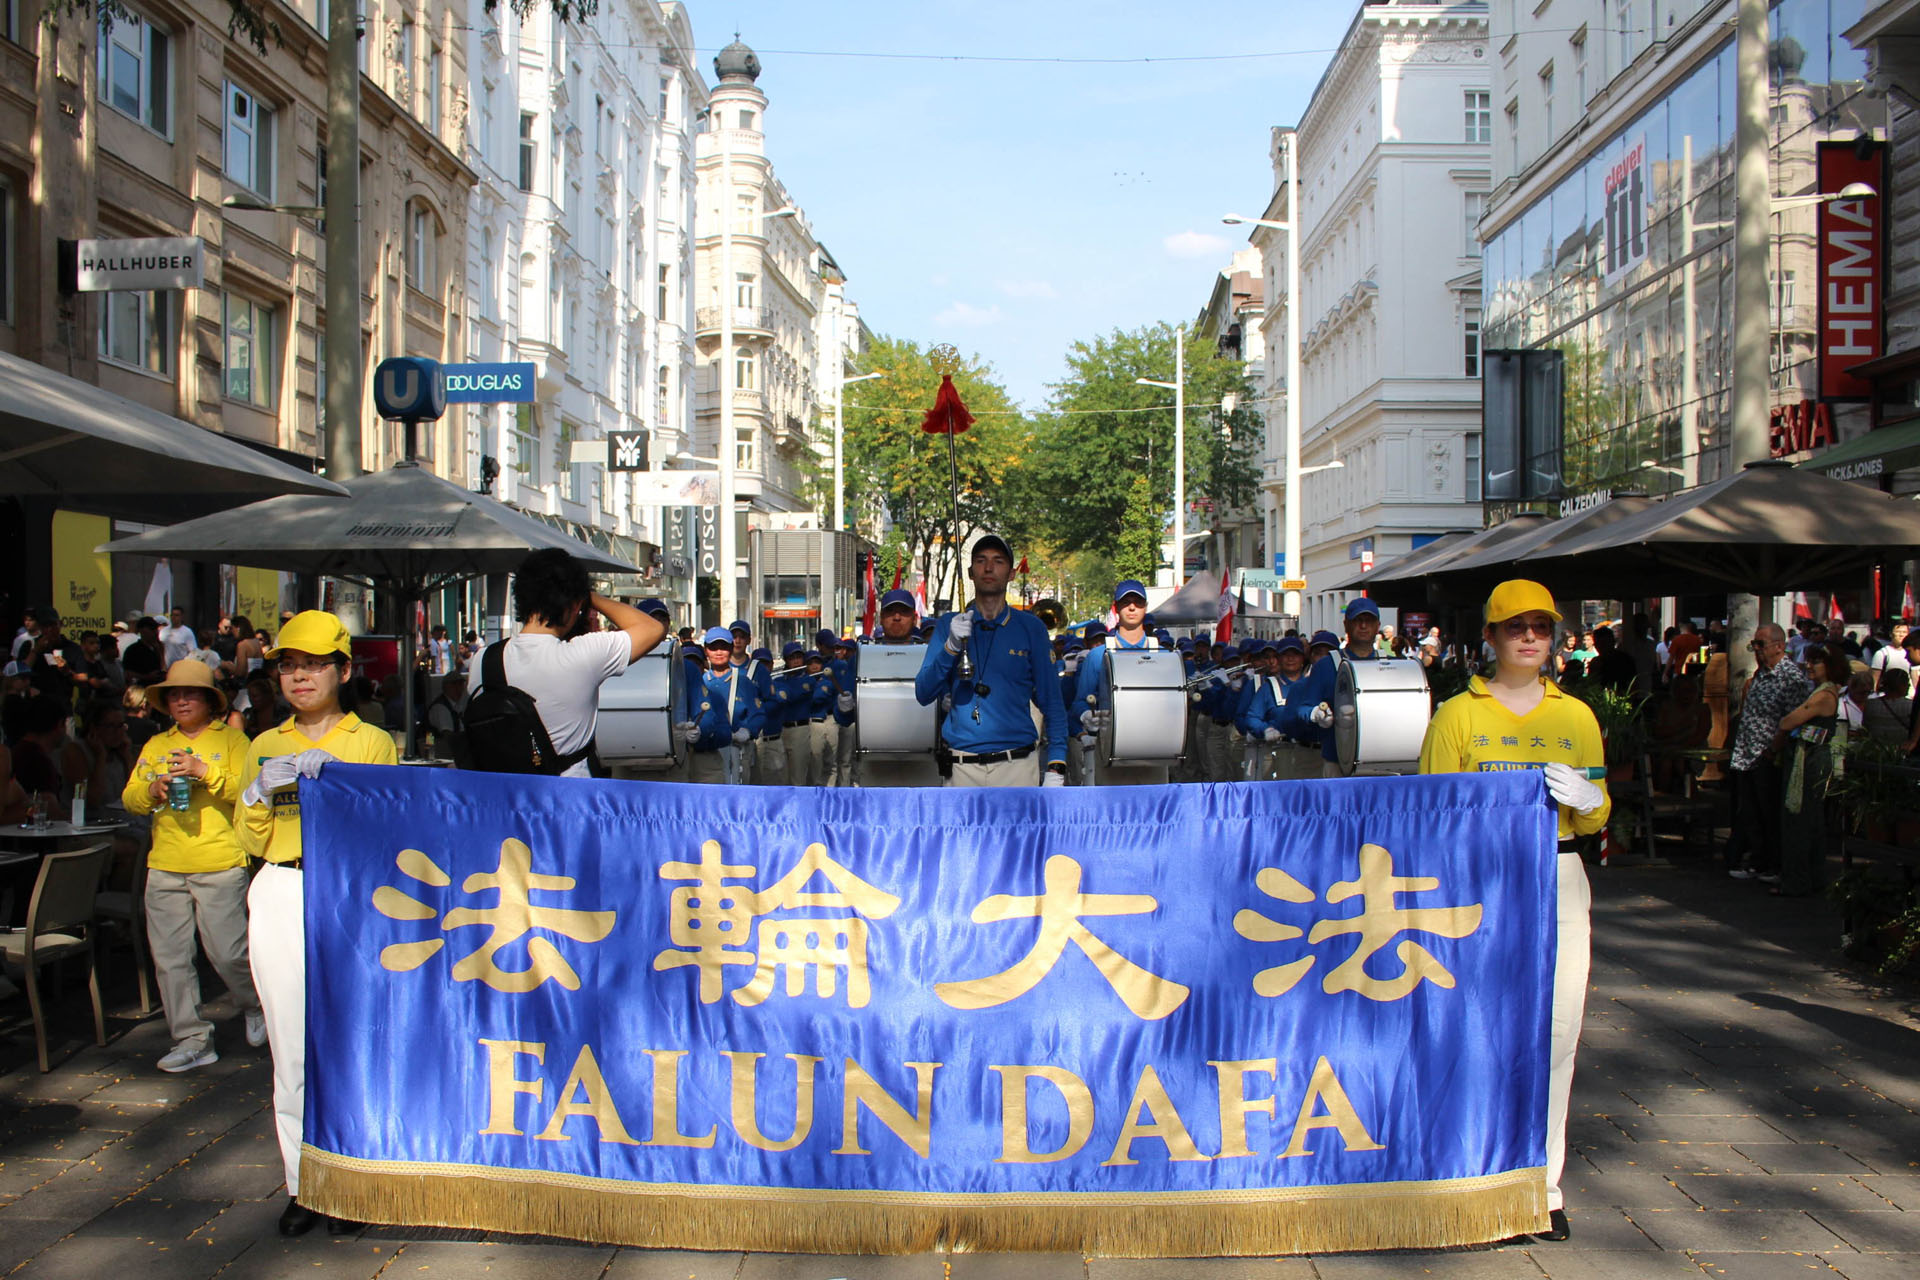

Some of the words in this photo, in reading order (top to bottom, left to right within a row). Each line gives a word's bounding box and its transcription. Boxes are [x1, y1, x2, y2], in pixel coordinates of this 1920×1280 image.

[1604, 143, 1644, 194] clever
[1605, 165, 1644, 276] fit
[82, 254, 194, 273] HALLHUBER
[1828, 200, 1873, 355] HEMA
[383, 369, 419, 409] U
[446, 374, 522, 391] DOUGLAS
[61, 616, 106, 628] OPENING
[1472, 734, 1574, 751] 法輪大法
[372, 837, 1483, 1020] 法輪大法
[478, 1038, 944, 1159] FALUN
[988, 1055, 1386, 1167] DAFA
